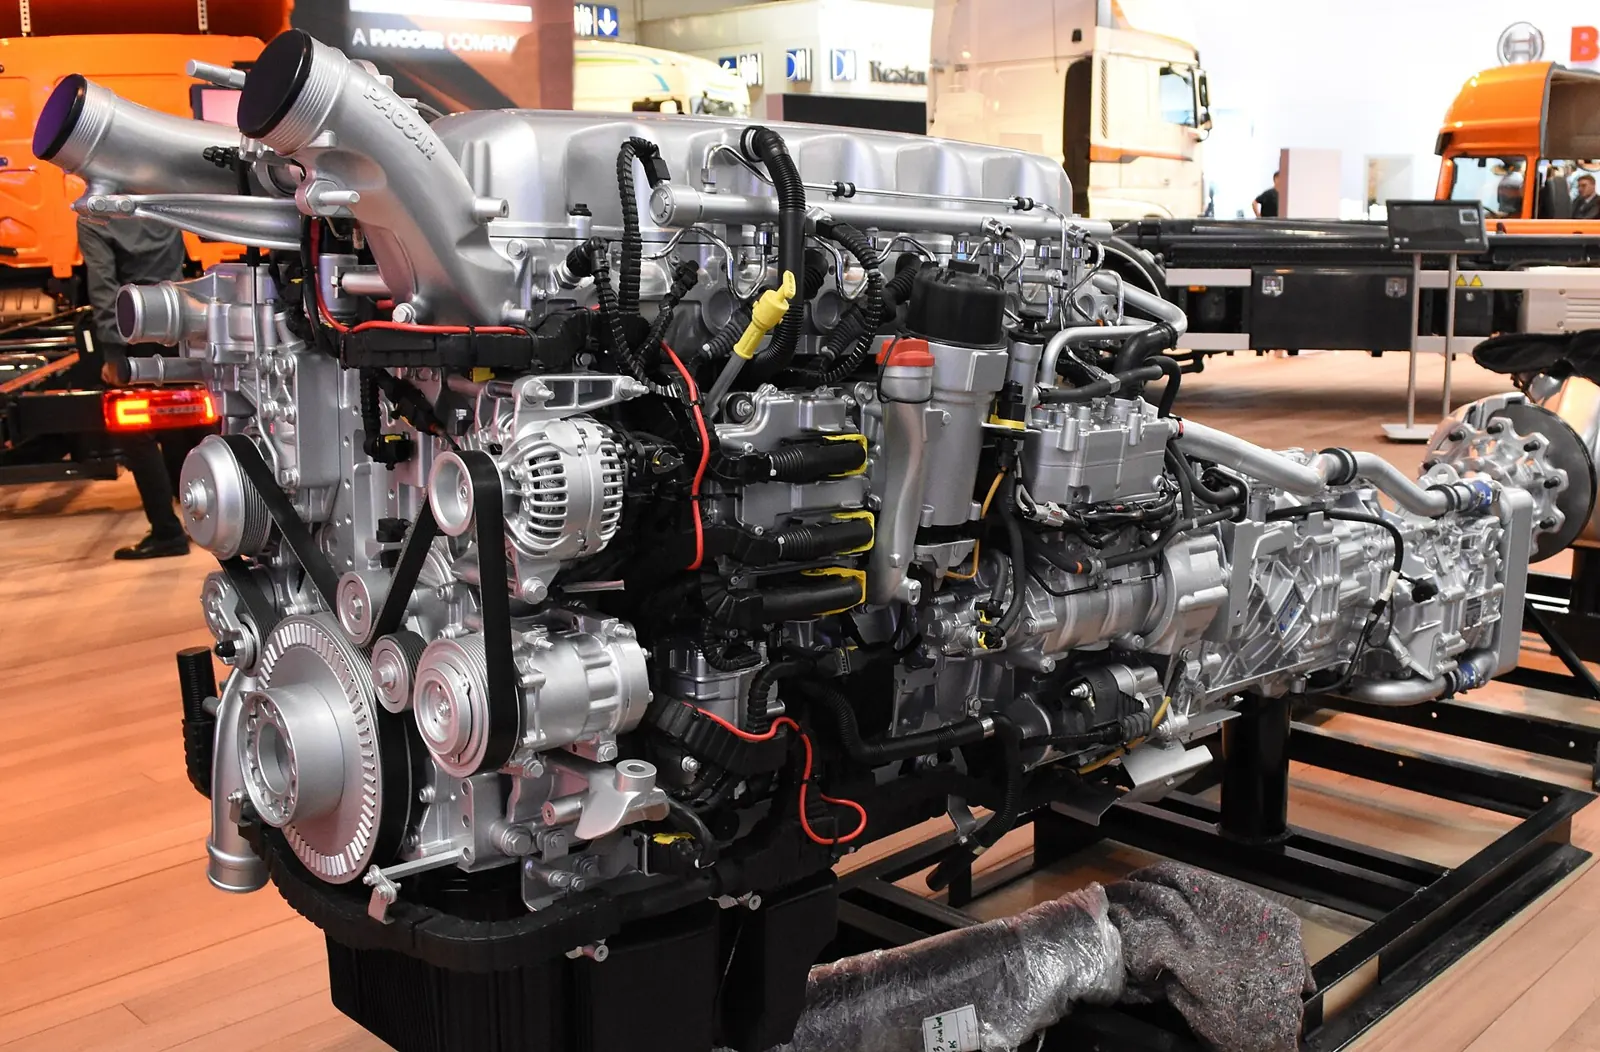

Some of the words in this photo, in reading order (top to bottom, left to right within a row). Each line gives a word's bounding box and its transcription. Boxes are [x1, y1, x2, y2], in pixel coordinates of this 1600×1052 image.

[352, 28, 367, 46] A
[369, 28, 445, 50] PACCAR
[1570, 26, 1600, 62] B
[363, 80, 436, 160] PACCAR
